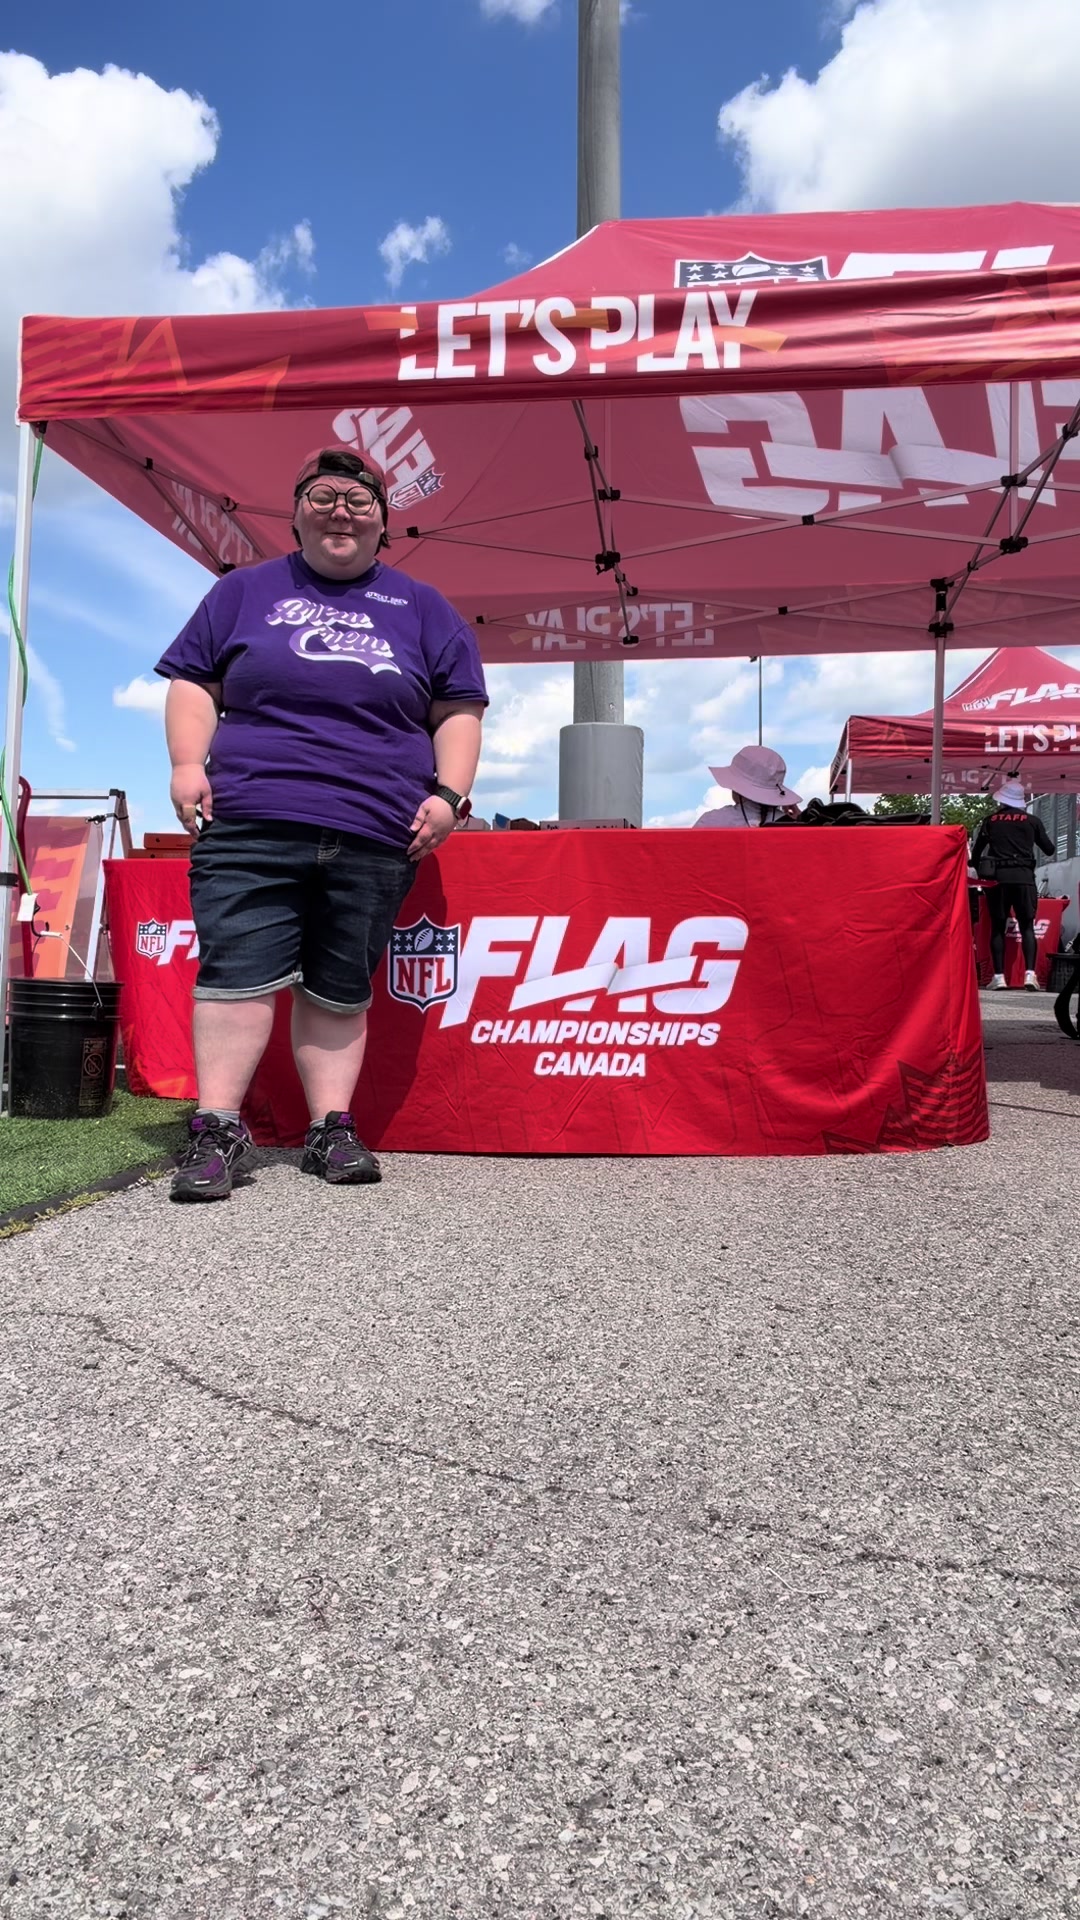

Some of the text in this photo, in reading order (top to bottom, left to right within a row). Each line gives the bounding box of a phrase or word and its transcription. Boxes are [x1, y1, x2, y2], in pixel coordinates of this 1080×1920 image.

[398, 289, 759, 381] LET'S PLAY
[264, 597, 375, 629] Brew
[289, 626, 402, 675] Crew
[984, 724, 1050, 753] LET'S
[990, 813, 1029, 822] STAFF
[140, 935, 164, 953] NFL
[394, 915, 750, 1029] NFL FLAG
[470, 1019, 722, 1048] CHAMPIONSHIPS
[532, 1050, 647, 1078] CANADA
